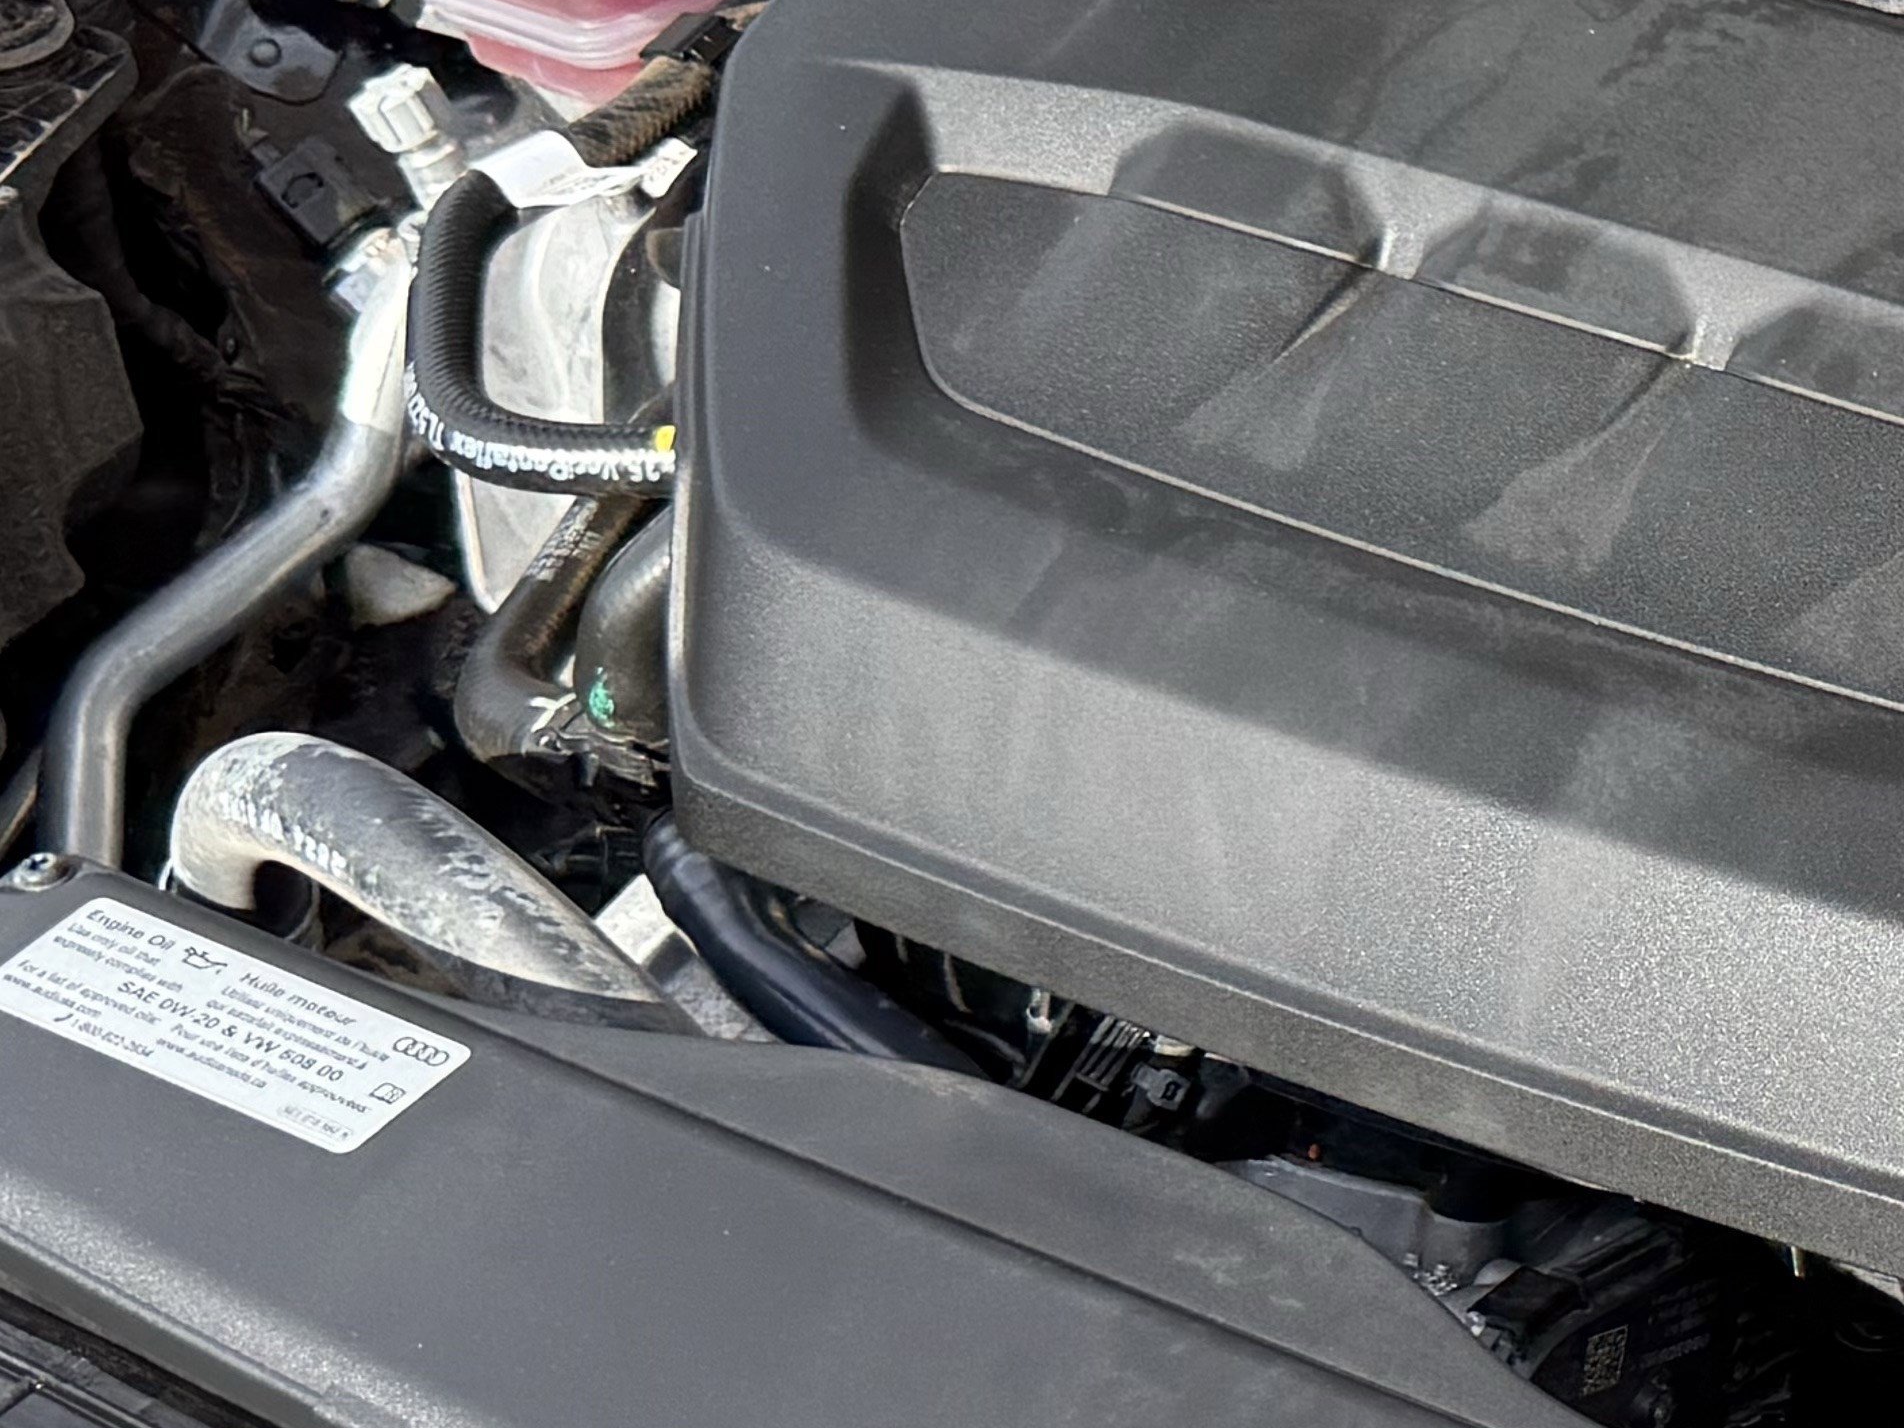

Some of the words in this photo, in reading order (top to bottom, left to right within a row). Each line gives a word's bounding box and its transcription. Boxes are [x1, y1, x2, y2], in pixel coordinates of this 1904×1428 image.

[84, 907, 147, 942] Engine
[146, 932, 176, 952] Oil
[116, 978, 160, 1005] SAE
[158, 995, 221, 1031] 0W-20
[220, 1022, 240, 1038] &
[241, 1031, 281, 1056] VW
[315, 1063, 345, 1083] 00
[286, 991, 358, 1029] moteur
